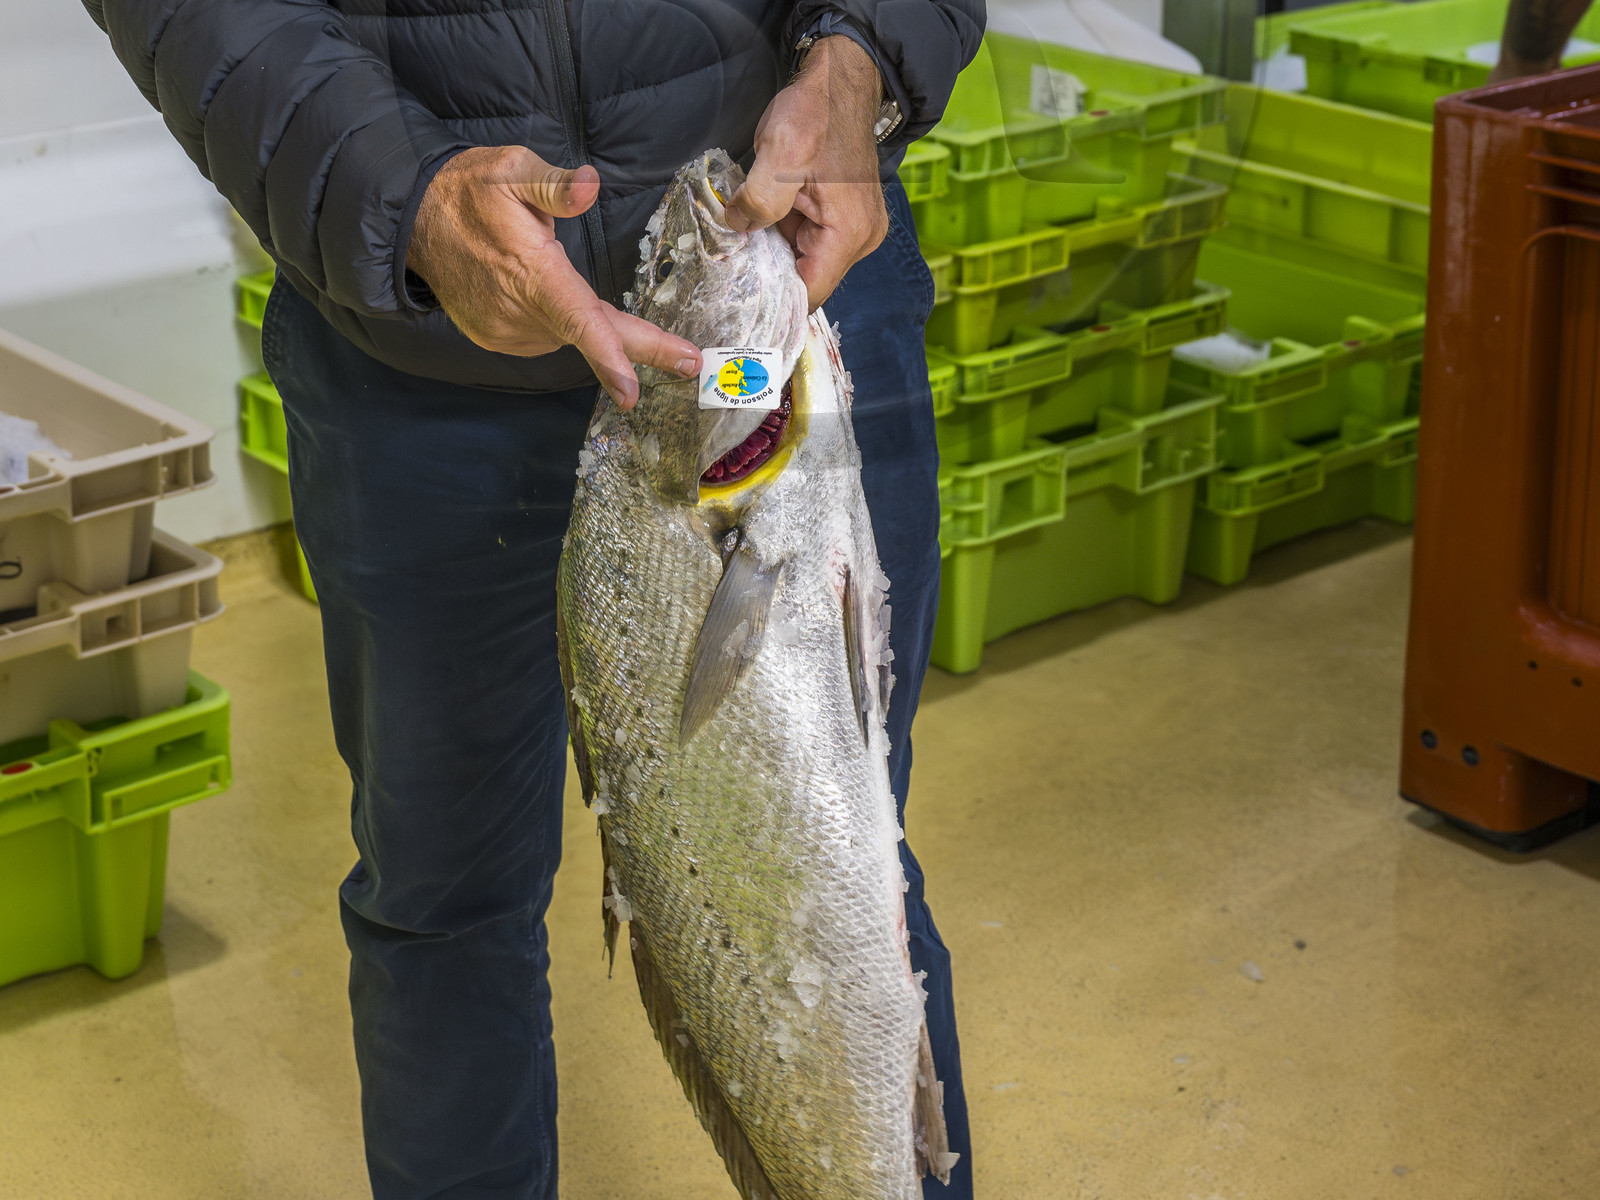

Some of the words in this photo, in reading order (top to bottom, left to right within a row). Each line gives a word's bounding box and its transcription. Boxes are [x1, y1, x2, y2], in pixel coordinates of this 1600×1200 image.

[714, 387, 729, 403] ligne
[730, 398, 740, 406] de
[741, 387, 773, 405] Poisson
